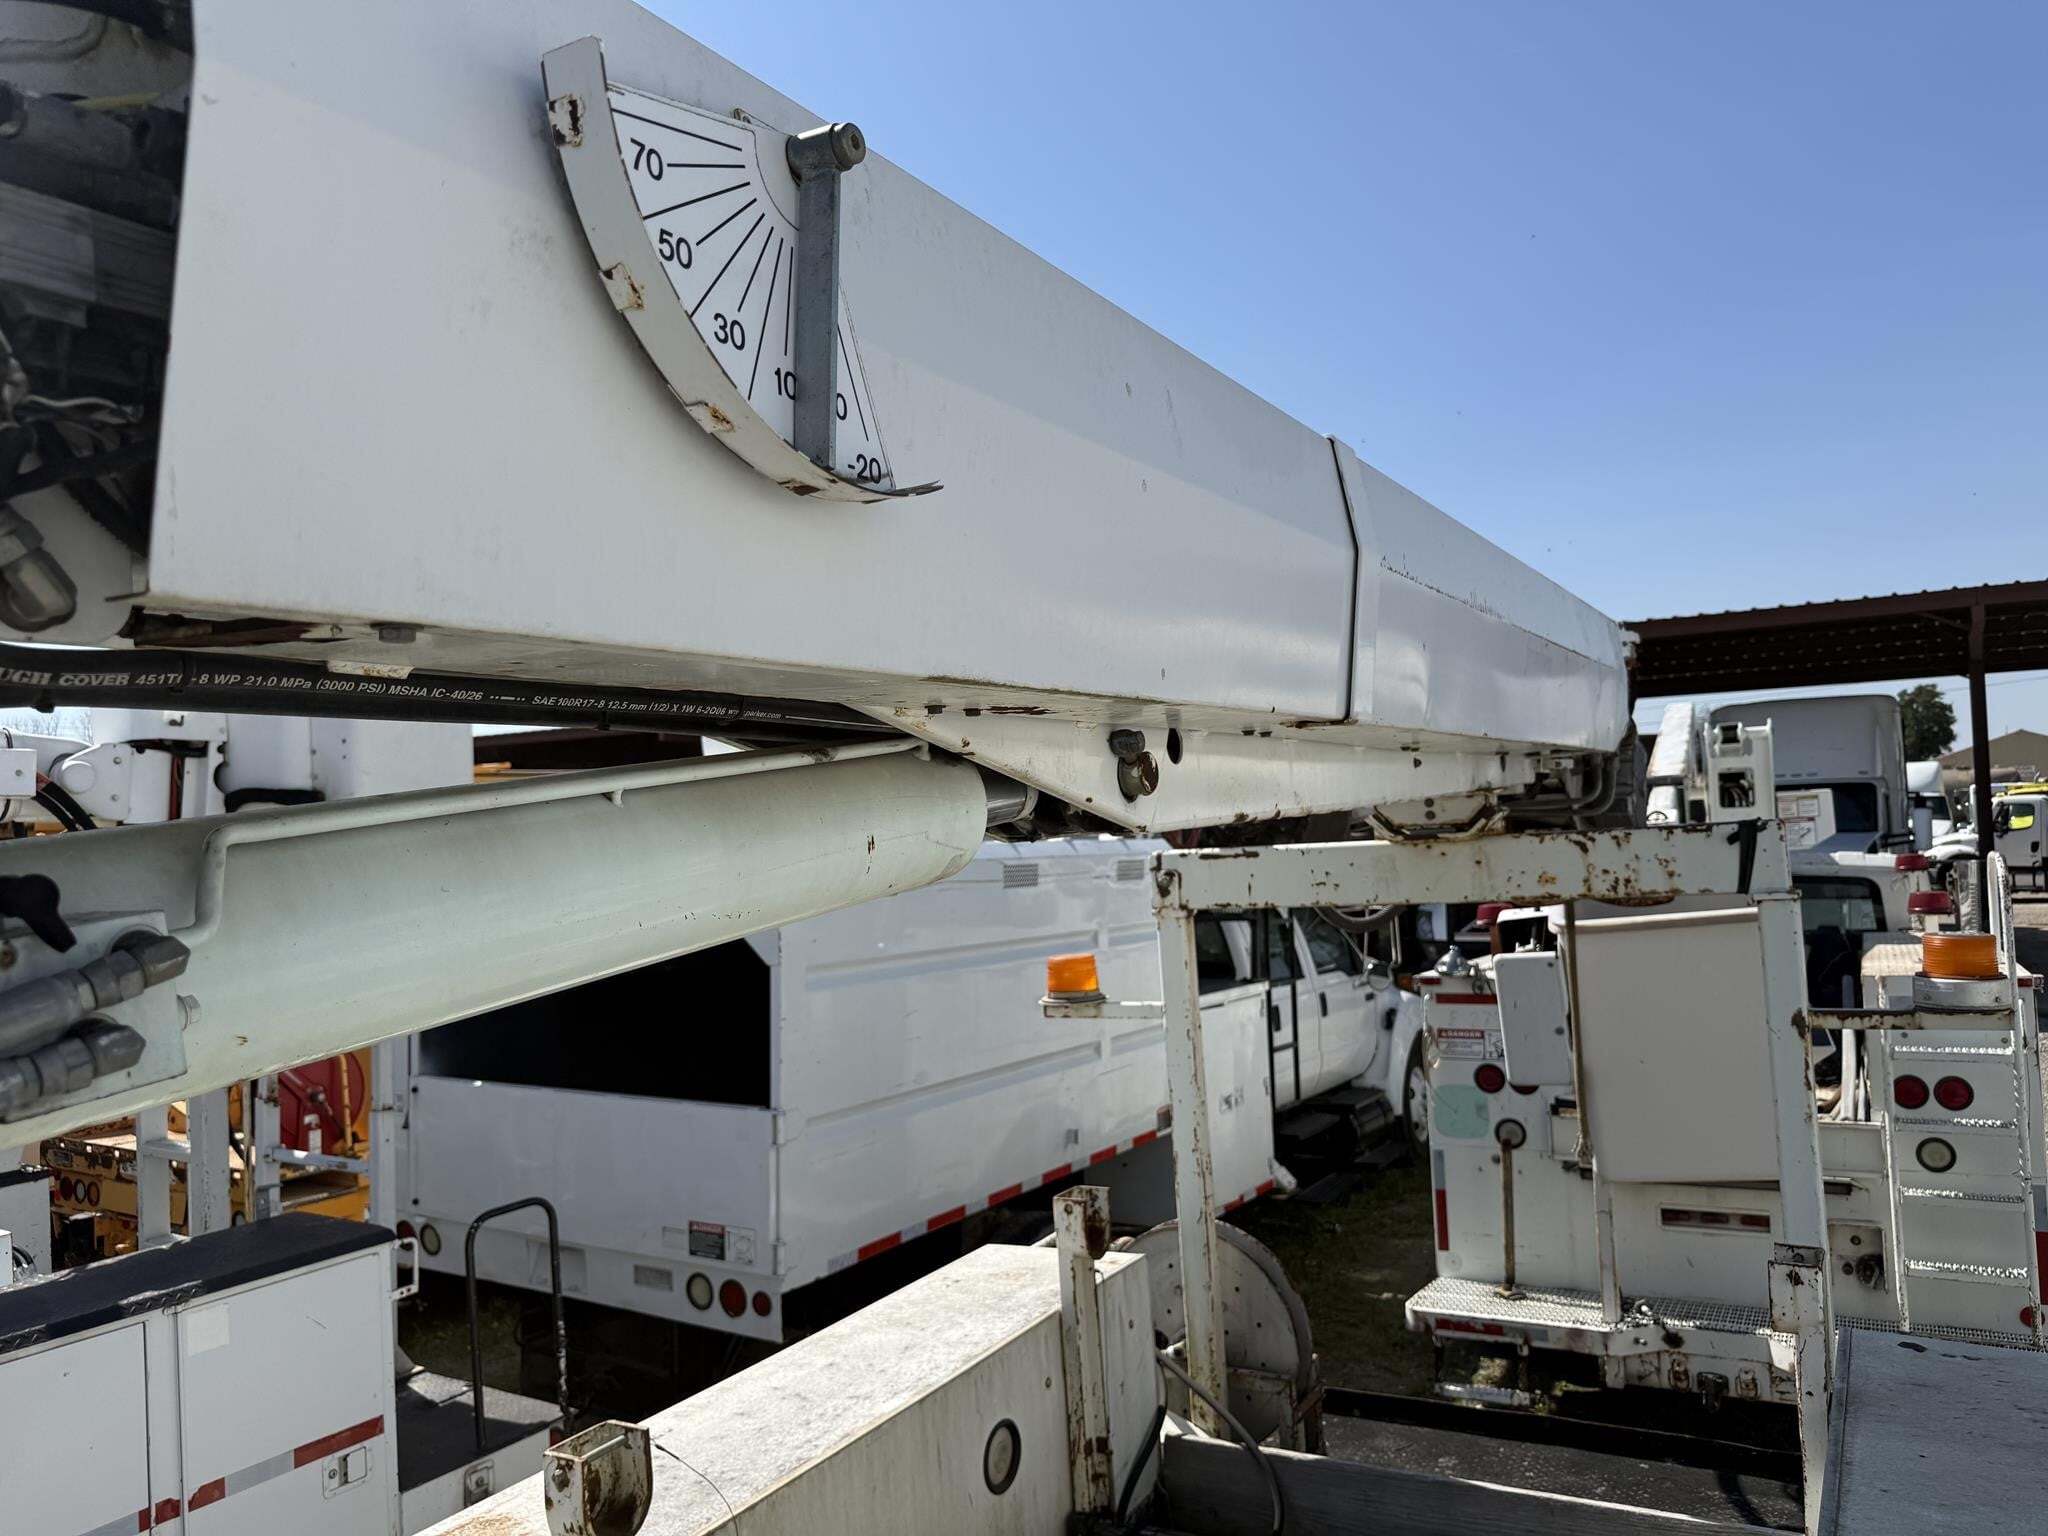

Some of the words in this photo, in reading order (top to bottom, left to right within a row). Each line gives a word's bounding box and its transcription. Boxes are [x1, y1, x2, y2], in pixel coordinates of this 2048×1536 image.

[630, 137, 664, 181] 70
[658, 228, 693, 270] 50
[713, 312, 746, 351] 30
[774, 367, 797, 401] 10
[847, 453, 882, 484] -20
[59, 672, 130, 687] COVER
[214, 673, 241, 685] WP
[243, 675, 278, 687] 21.0
[279, 677, 312, 689] MPa
[316, 678, 355, 691] (3000
[357, 682, 387, 694] PSI)
[388, 685, 428, 697] MSHA
[431, 688, 484, 701] IC-40/26
[608, 700, 629, 710] 12.5
[648, 702, 670, 712] (1/2)
